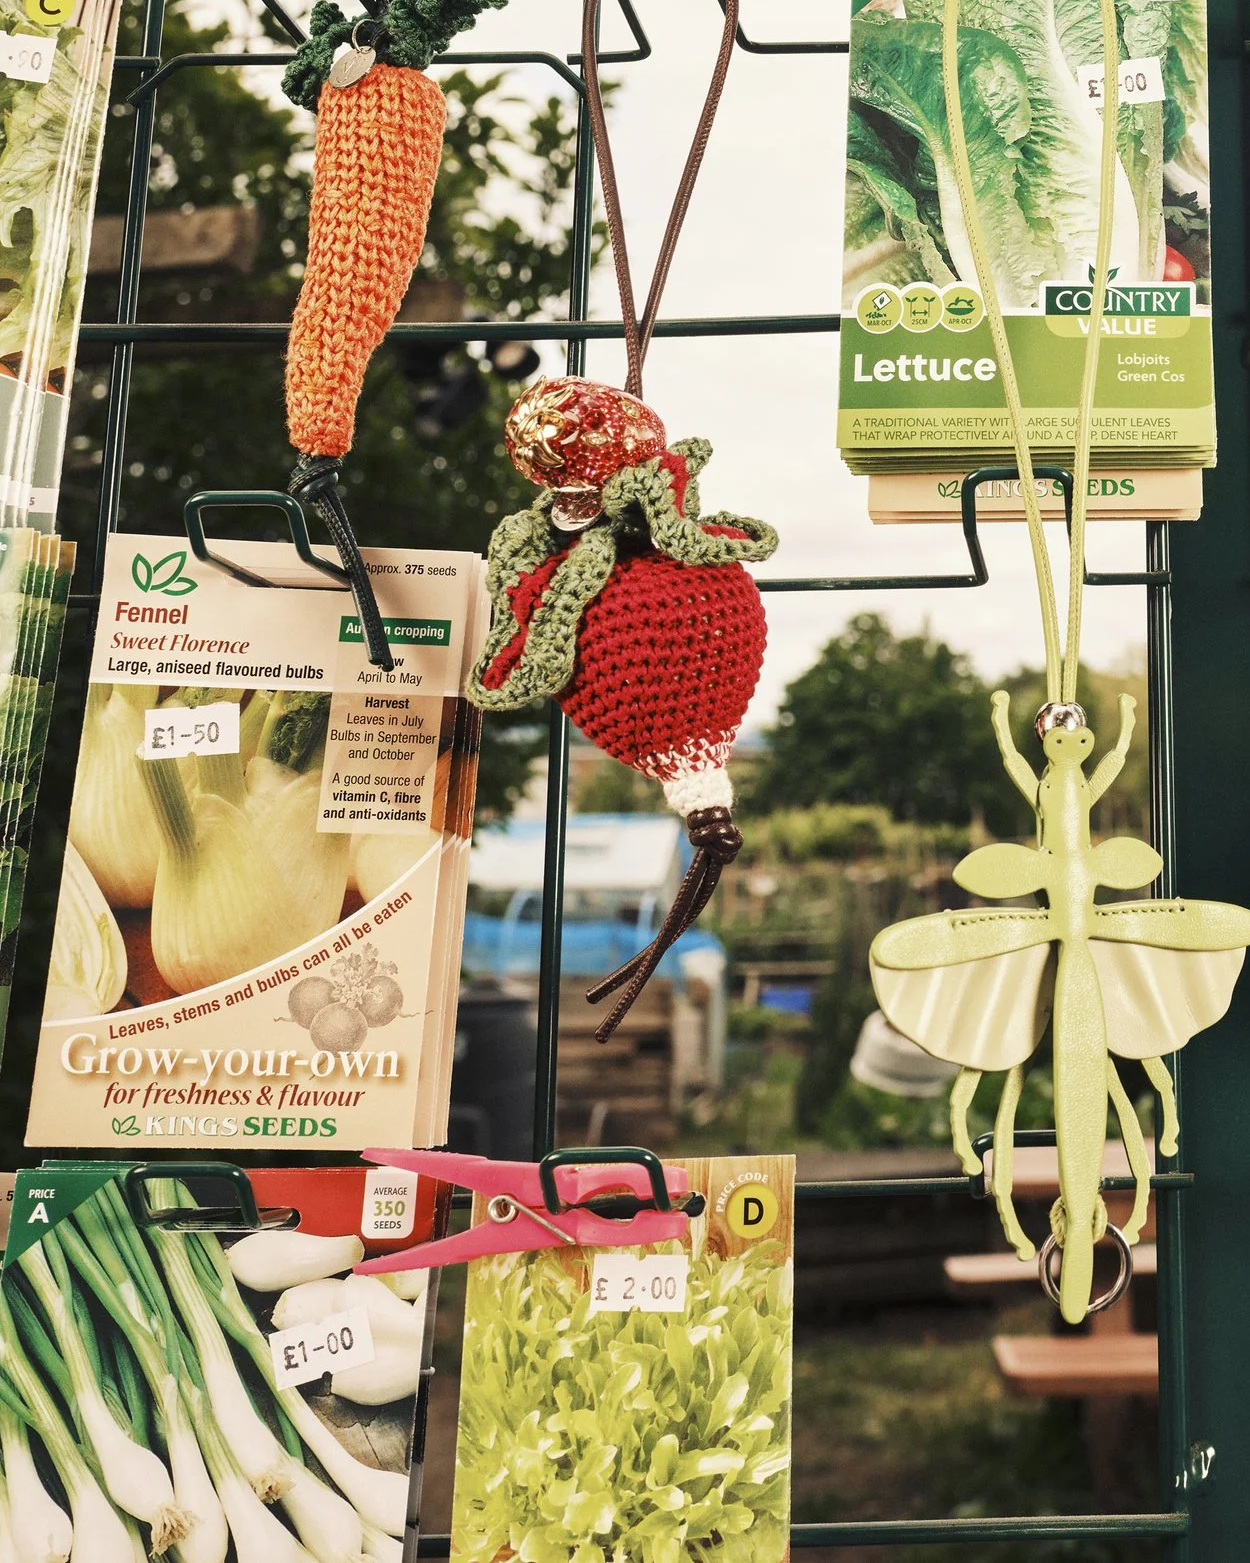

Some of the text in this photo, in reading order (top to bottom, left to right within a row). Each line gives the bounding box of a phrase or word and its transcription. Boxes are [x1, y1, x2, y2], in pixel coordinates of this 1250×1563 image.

[867, 319, 893, 327] MAR-OCT
[1077, 317, 1157, 335] VALUE
[854, 354, 997, 382] Lettuce
[1117, 353, 1170, 368] Lobjoits
[1117, 370, 1185, 382] Green Cos
[864, 417, 1171, 427] TRADITIONAL VARIETY LEAVES
[852, 430, 1178, 440] THAT WRAP PROTECTIVELY DENSE HEART
[404, 563, 425, 575] 375
[427, 565, 457, 576] seeds
[115, 601, 189, 625] Fennel
[394, 626, 445, 640] cropping
[110, 632, 250, 654] Sweet Florence
[108, 657, 324, 680] Large, aniseed flavoured bulbs
[357, 671, 422, 686] April May
[364, 696, 410, 709] Harvest
[346, 713, 424, 729] Leaves July
[151, 721, 220, 749] £1-50
[330, 729, 437, 746] Bulbs September
[348, 747, 415, 761] and October
[343, 773, 411, 787] good source
[332, 790, 421, 804] vitamin fibre
[323, 807, 427, 822] and anti-oxidants
[109, 891, 412, 1040] Leaves, stems and bulbs can all be eaten
[60, 1032, 400, 1087] Grow-your-own
[103, 1082, 366, 1111] for freshness & flavour
[144, 1115, 337, 1137] KINGS SEEDS
[28, 1188, 55, 1199] PRICE
[373, 1187, 408, 1196] AVERAGE
[716, 1172, 770, 1213] PRICE CODE
[27, 1202, 49, 1224] A
[373, 1200, 406, 1217] 350
[743, 1197, 764, 1226] D
[374, 1220, 402, 1229] SEEDS
[283, 1326, 354, 1371] £1-00
